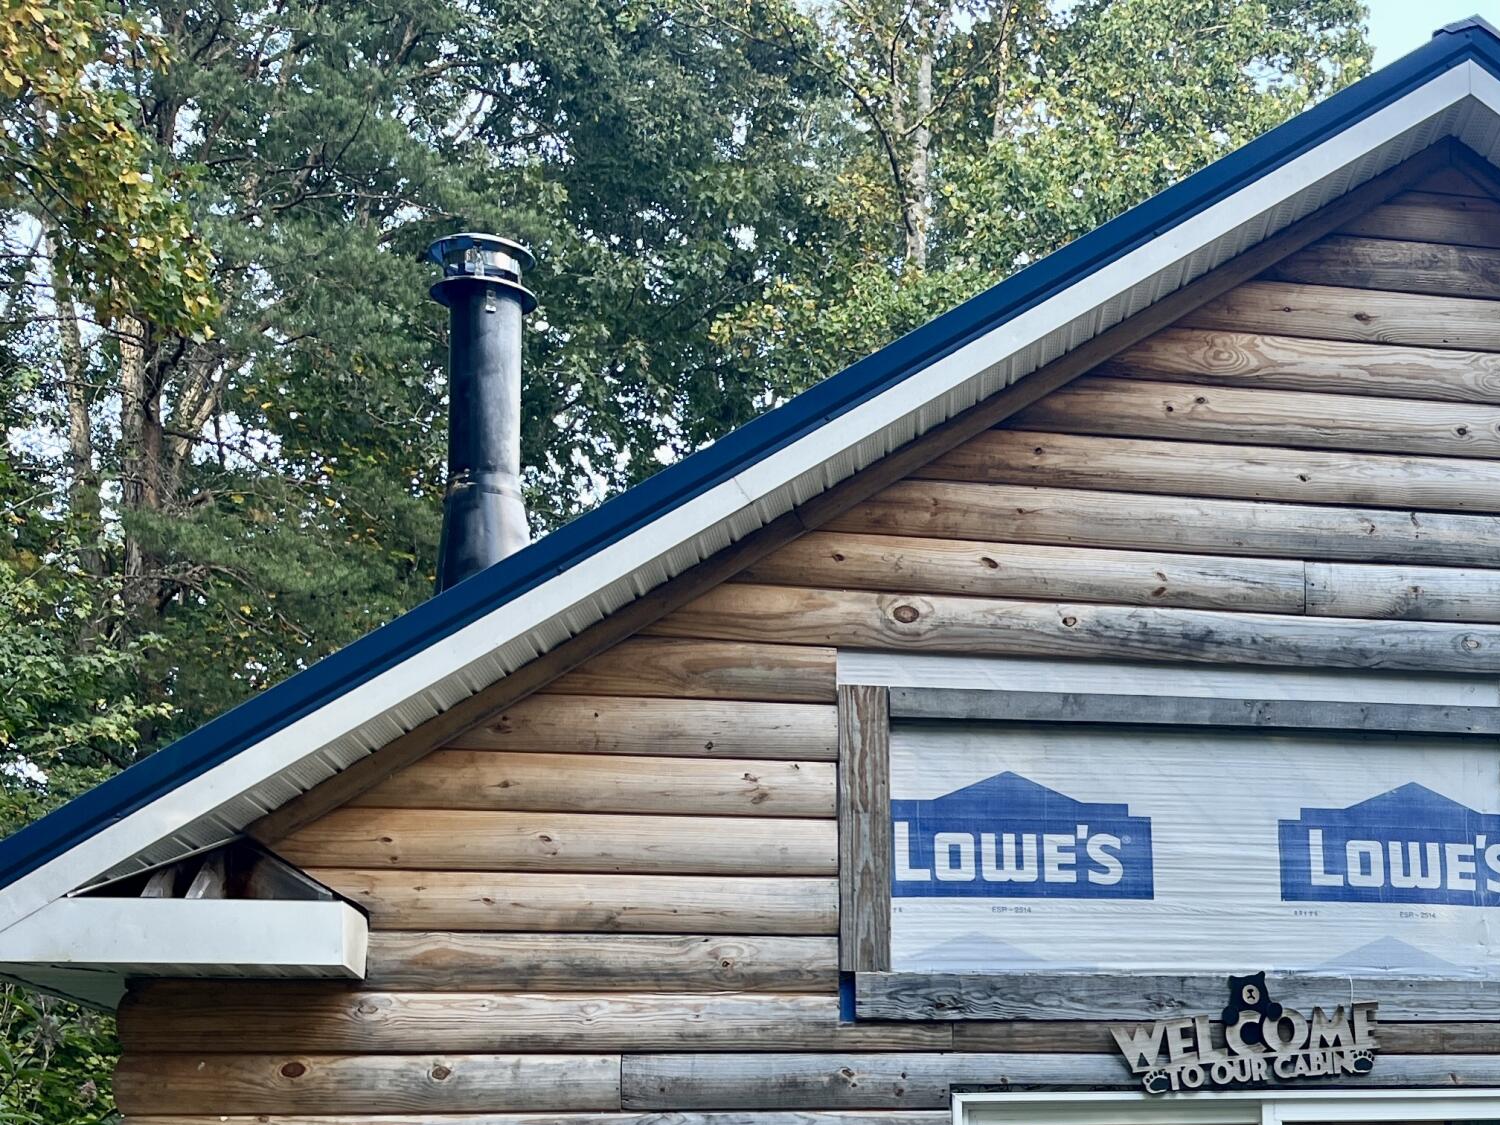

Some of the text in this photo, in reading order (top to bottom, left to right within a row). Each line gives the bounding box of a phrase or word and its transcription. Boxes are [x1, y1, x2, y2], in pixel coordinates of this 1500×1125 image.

[894, 821, 1123, 885] LOWE'S
[1110, 1001, 1380, 1073] WELCOME
[1167, 1050, 1353, 1090] TO OUR CABIN
